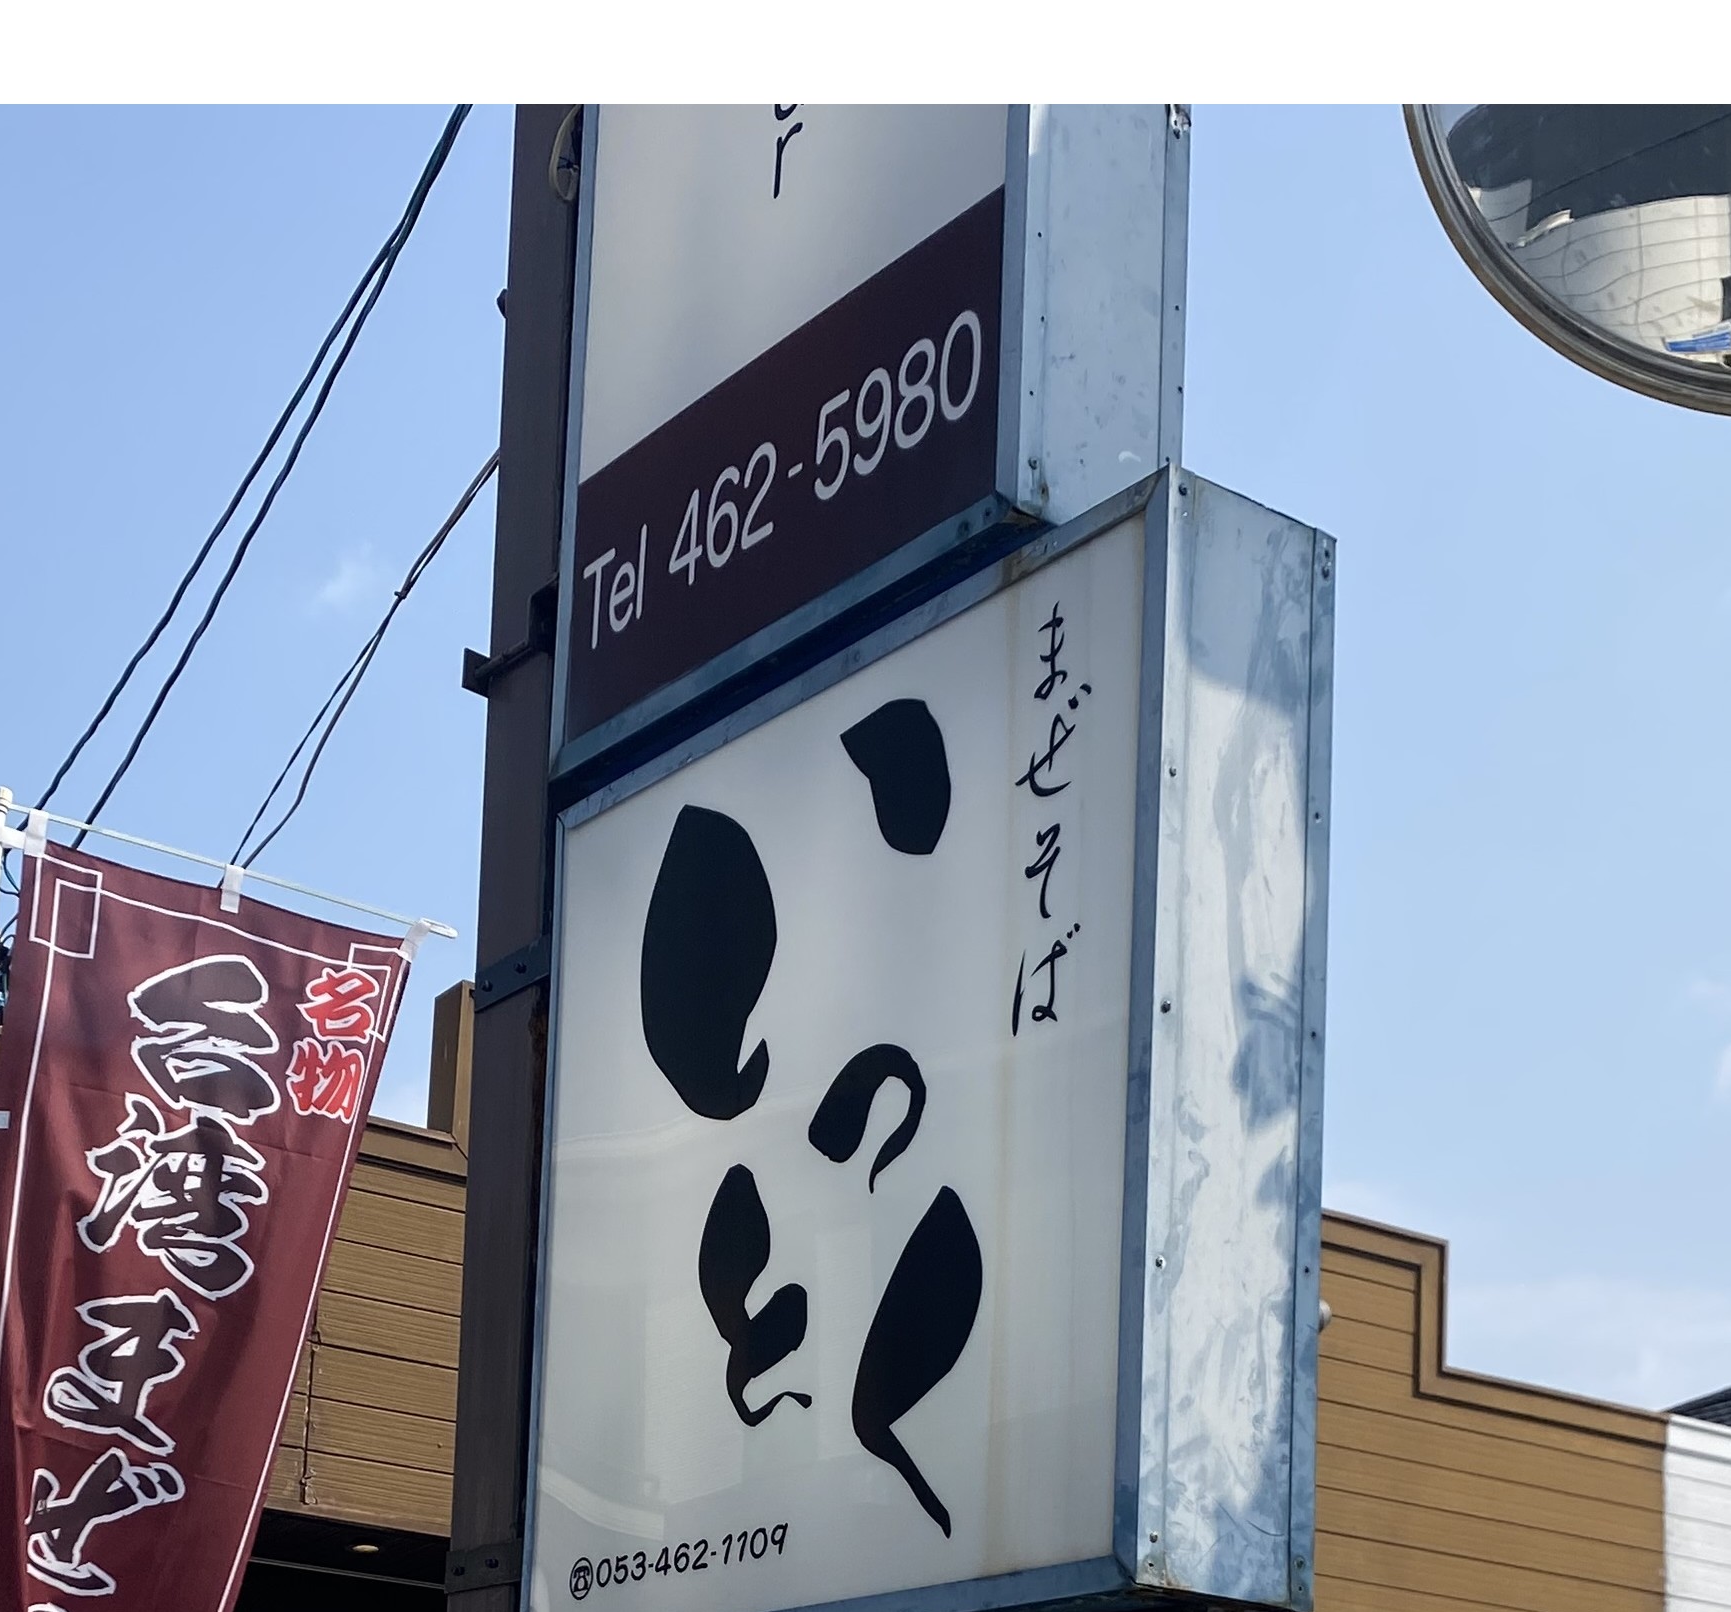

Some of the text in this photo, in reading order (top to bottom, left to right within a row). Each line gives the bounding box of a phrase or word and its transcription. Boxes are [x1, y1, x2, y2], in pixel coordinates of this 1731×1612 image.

[582, 308, 983, 650] Tel 462-5980
[1013, 600, 1093, 1037] まぜそば
[287, 966, 379, 1124] 名物
[596, 1523, 789, 1588] 053-462-1109
